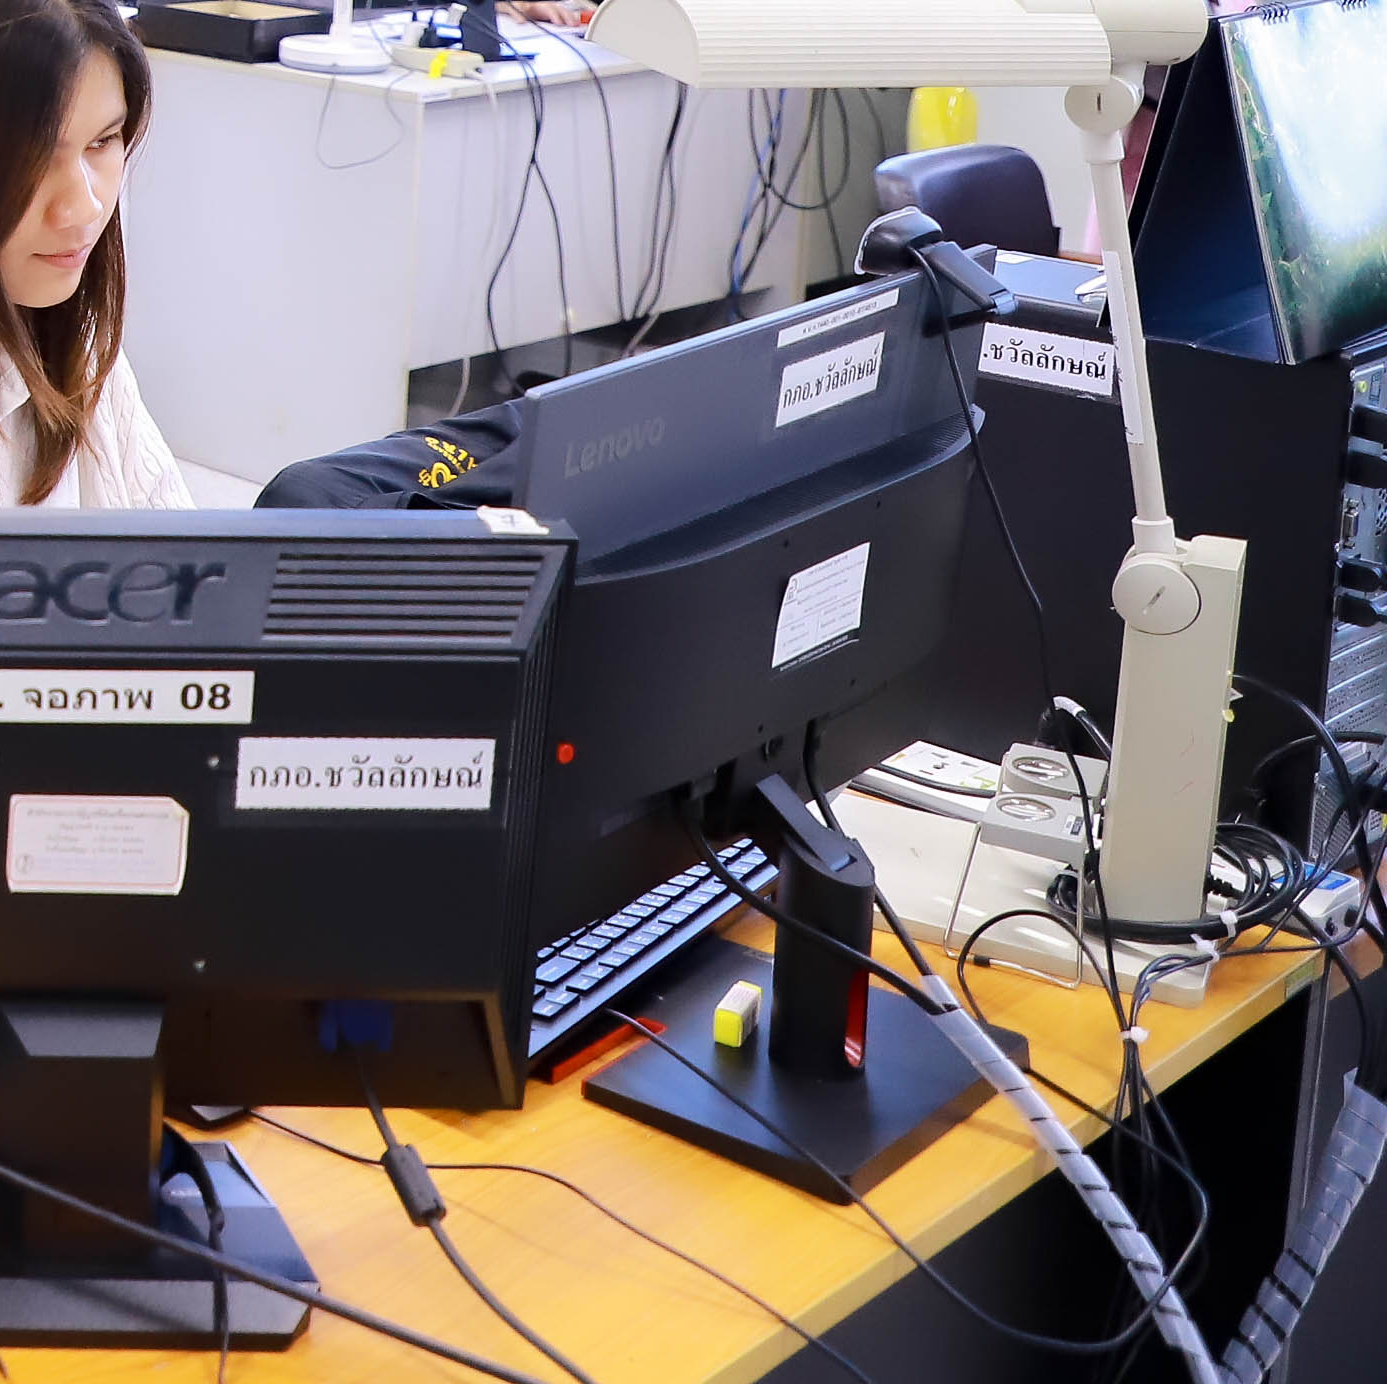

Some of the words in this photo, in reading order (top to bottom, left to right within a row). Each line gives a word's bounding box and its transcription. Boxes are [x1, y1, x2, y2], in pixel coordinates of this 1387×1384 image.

[783, 341, 881, 409] กภอ.ชวัลลักษณ์
[565, 417, 667, 481] Lenovo
[25, 683, 154, 711] จอภาพ
[180, 682, 232, 711] 08
[249, 750, 485, 790] กภอ.ชวัลลักษณ์
